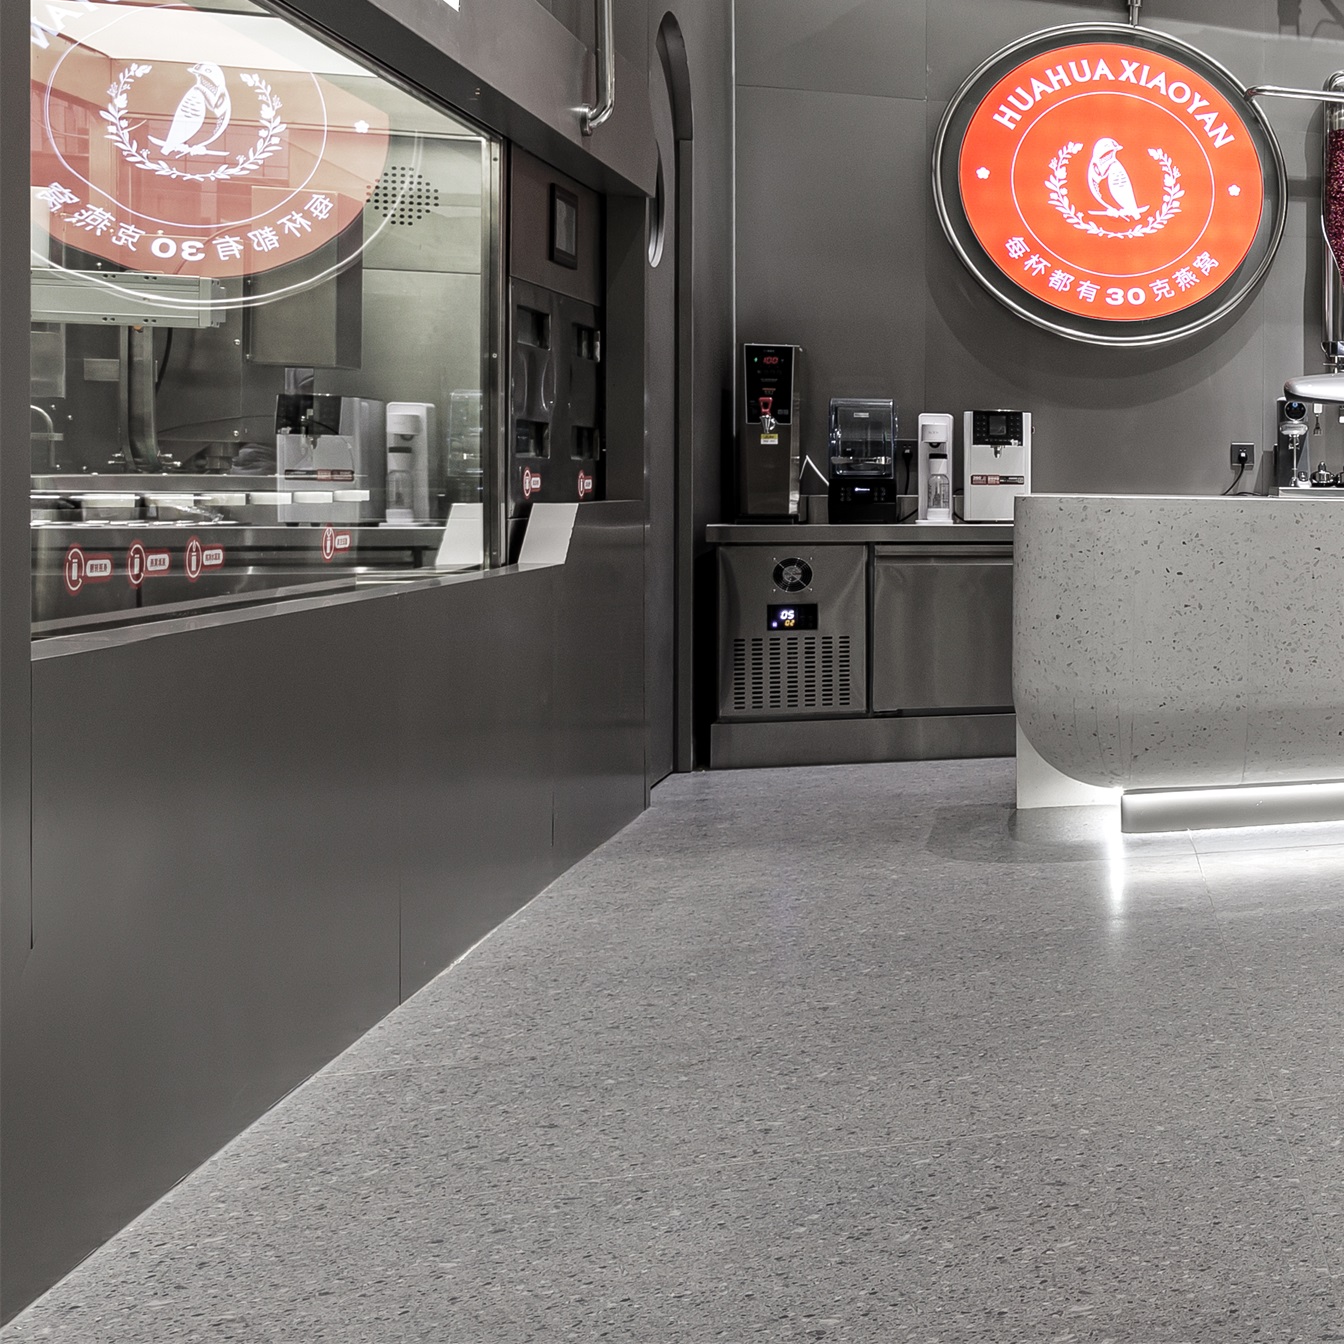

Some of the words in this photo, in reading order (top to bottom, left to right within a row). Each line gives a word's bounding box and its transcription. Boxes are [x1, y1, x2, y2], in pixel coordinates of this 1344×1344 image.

[992, 59, 1115, 131] HUAHUA
[1118, 59, 1235, 149] XIAOYAN
[1005, 235, 1219, 306] 每杯都有30克燕窝
